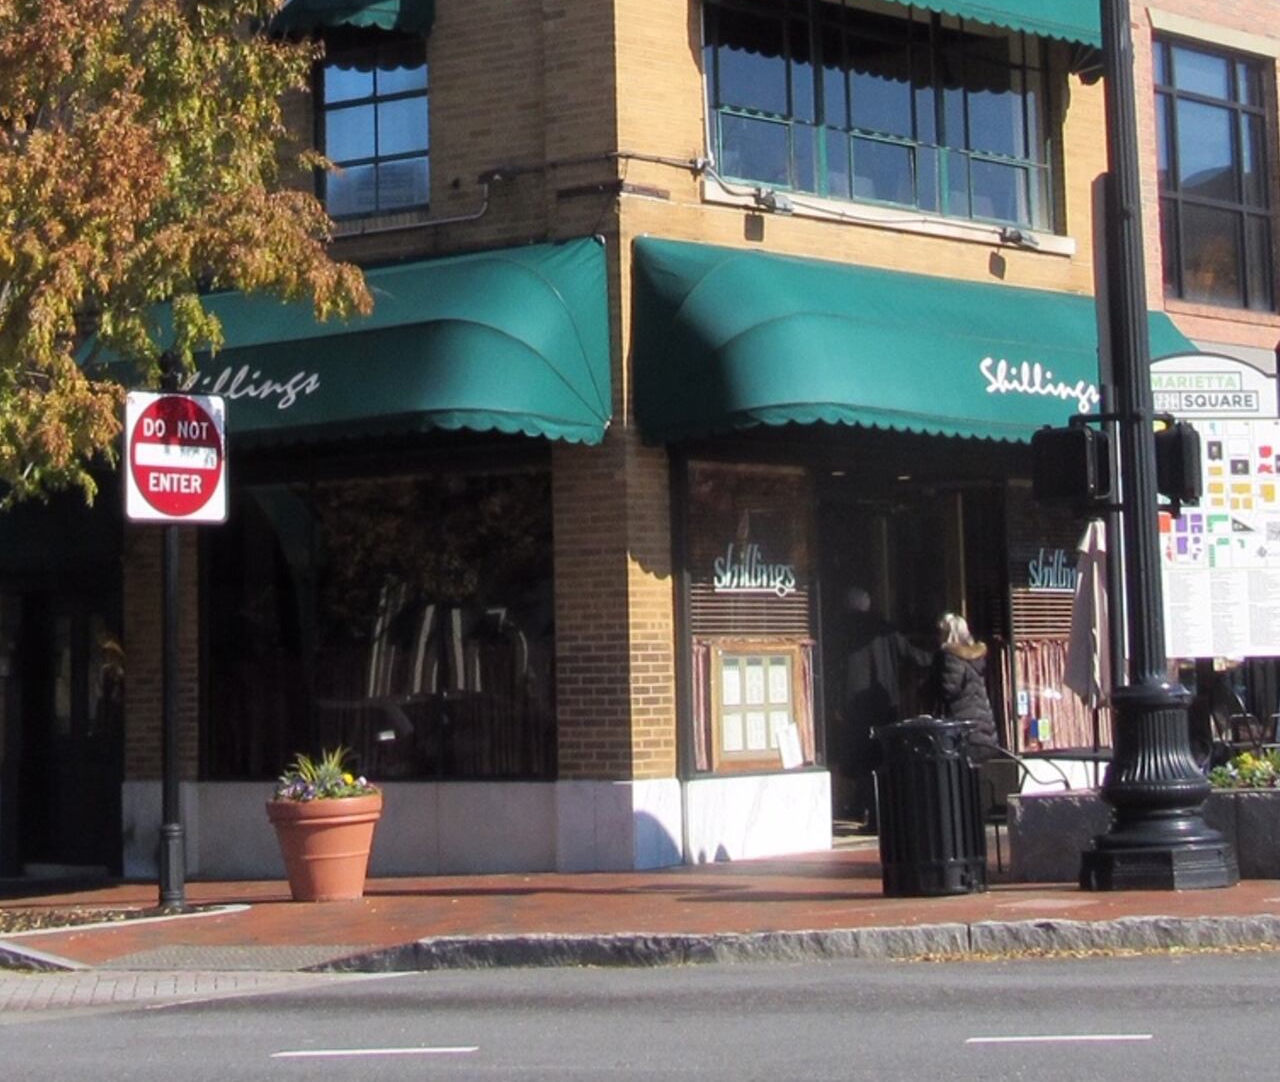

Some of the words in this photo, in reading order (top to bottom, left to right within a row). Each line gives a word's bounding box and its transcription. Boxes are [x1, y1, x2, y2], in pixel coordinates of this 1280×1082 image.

[177, 365, 320, 409] llings
[980, 358, 1100, 413] Shillings
[1151, 376, 1237, 388] MARIETTA
[1184, 394, 1253, 408] SQUARE
[143, 418, 166, 437] DO
[177, 420, 208, 440] NOT
[149, 472, 202, 493] ENTER
[714, 542, 796, 597] shillings
[1029, 548, 1076, 588] shillin
